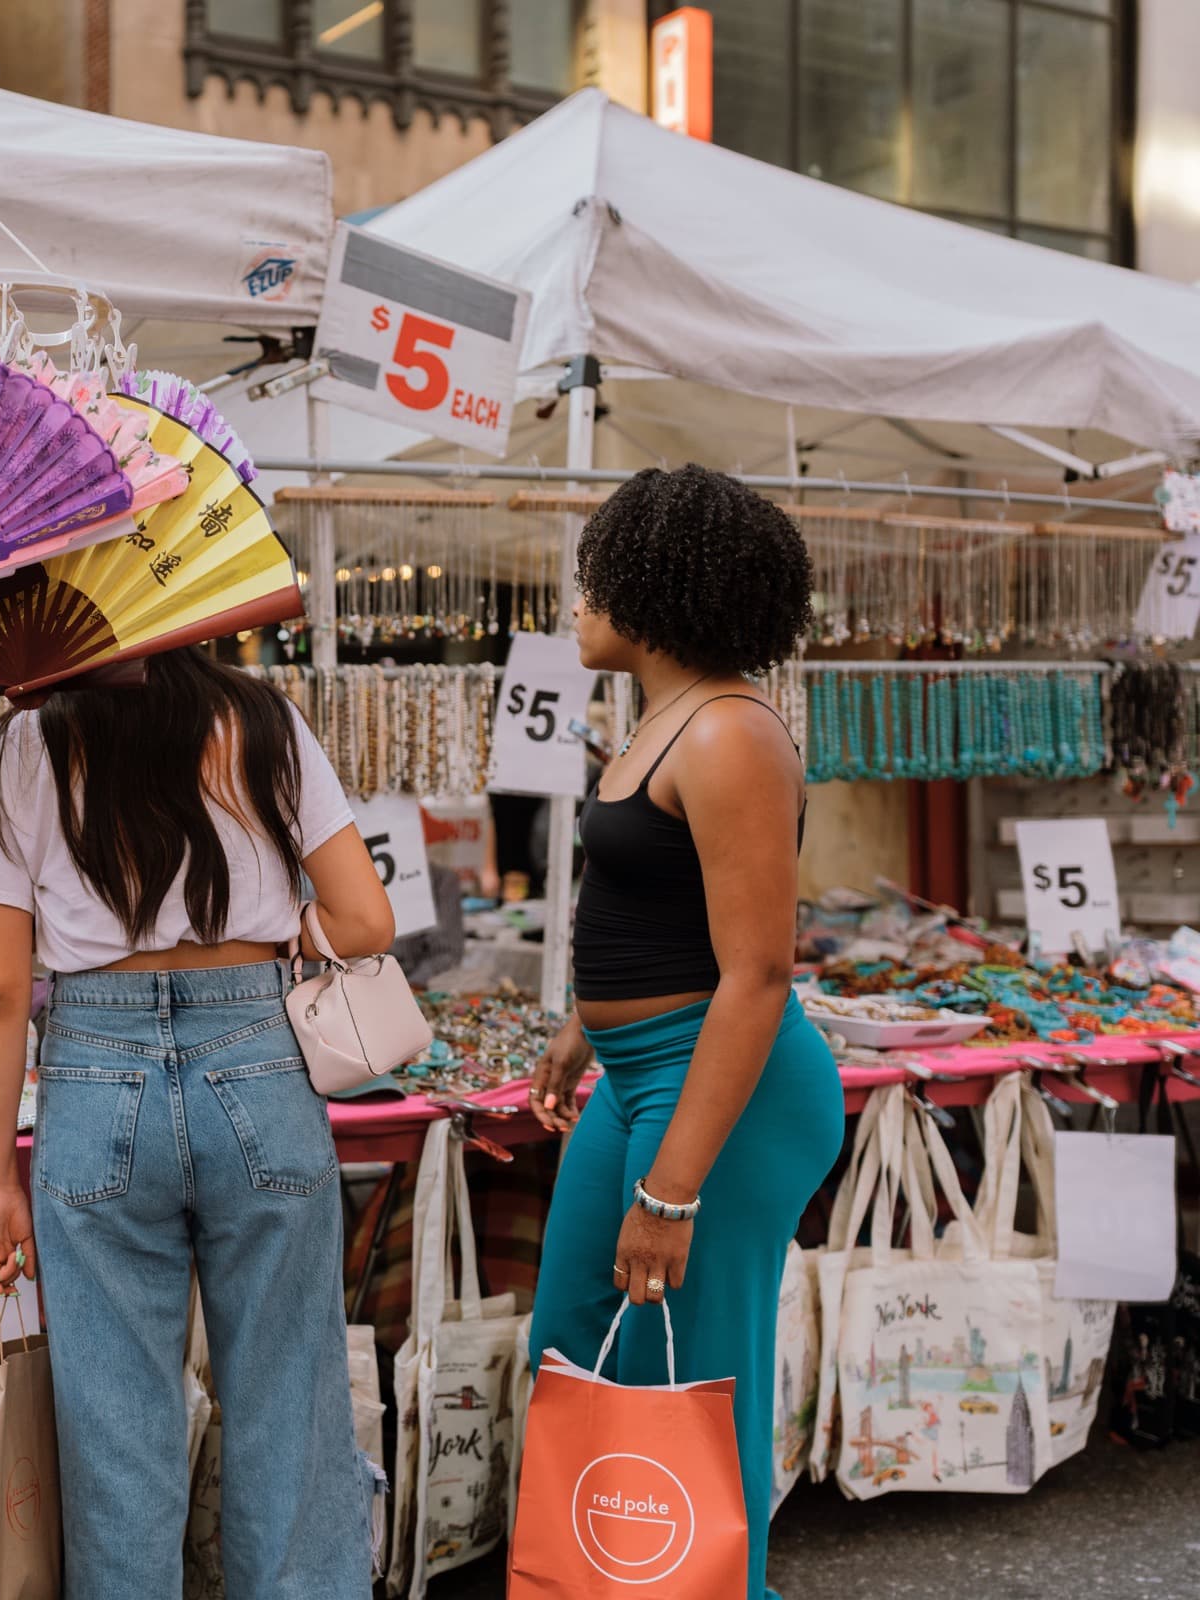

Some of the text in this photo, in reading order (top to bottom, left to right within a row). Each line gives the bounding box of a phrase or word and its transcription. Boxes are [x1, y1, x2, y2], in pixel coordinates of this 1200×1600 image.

[370, 305, 501, 430] $5 EACH
[1156, 551, 1197, 596] $5
[506, 683, 560, 742] $5
[1032, 864, 1088, 909] $5
[897, 1292, 943, 1321] York
[592, 1489, 670, 1516] red poke
